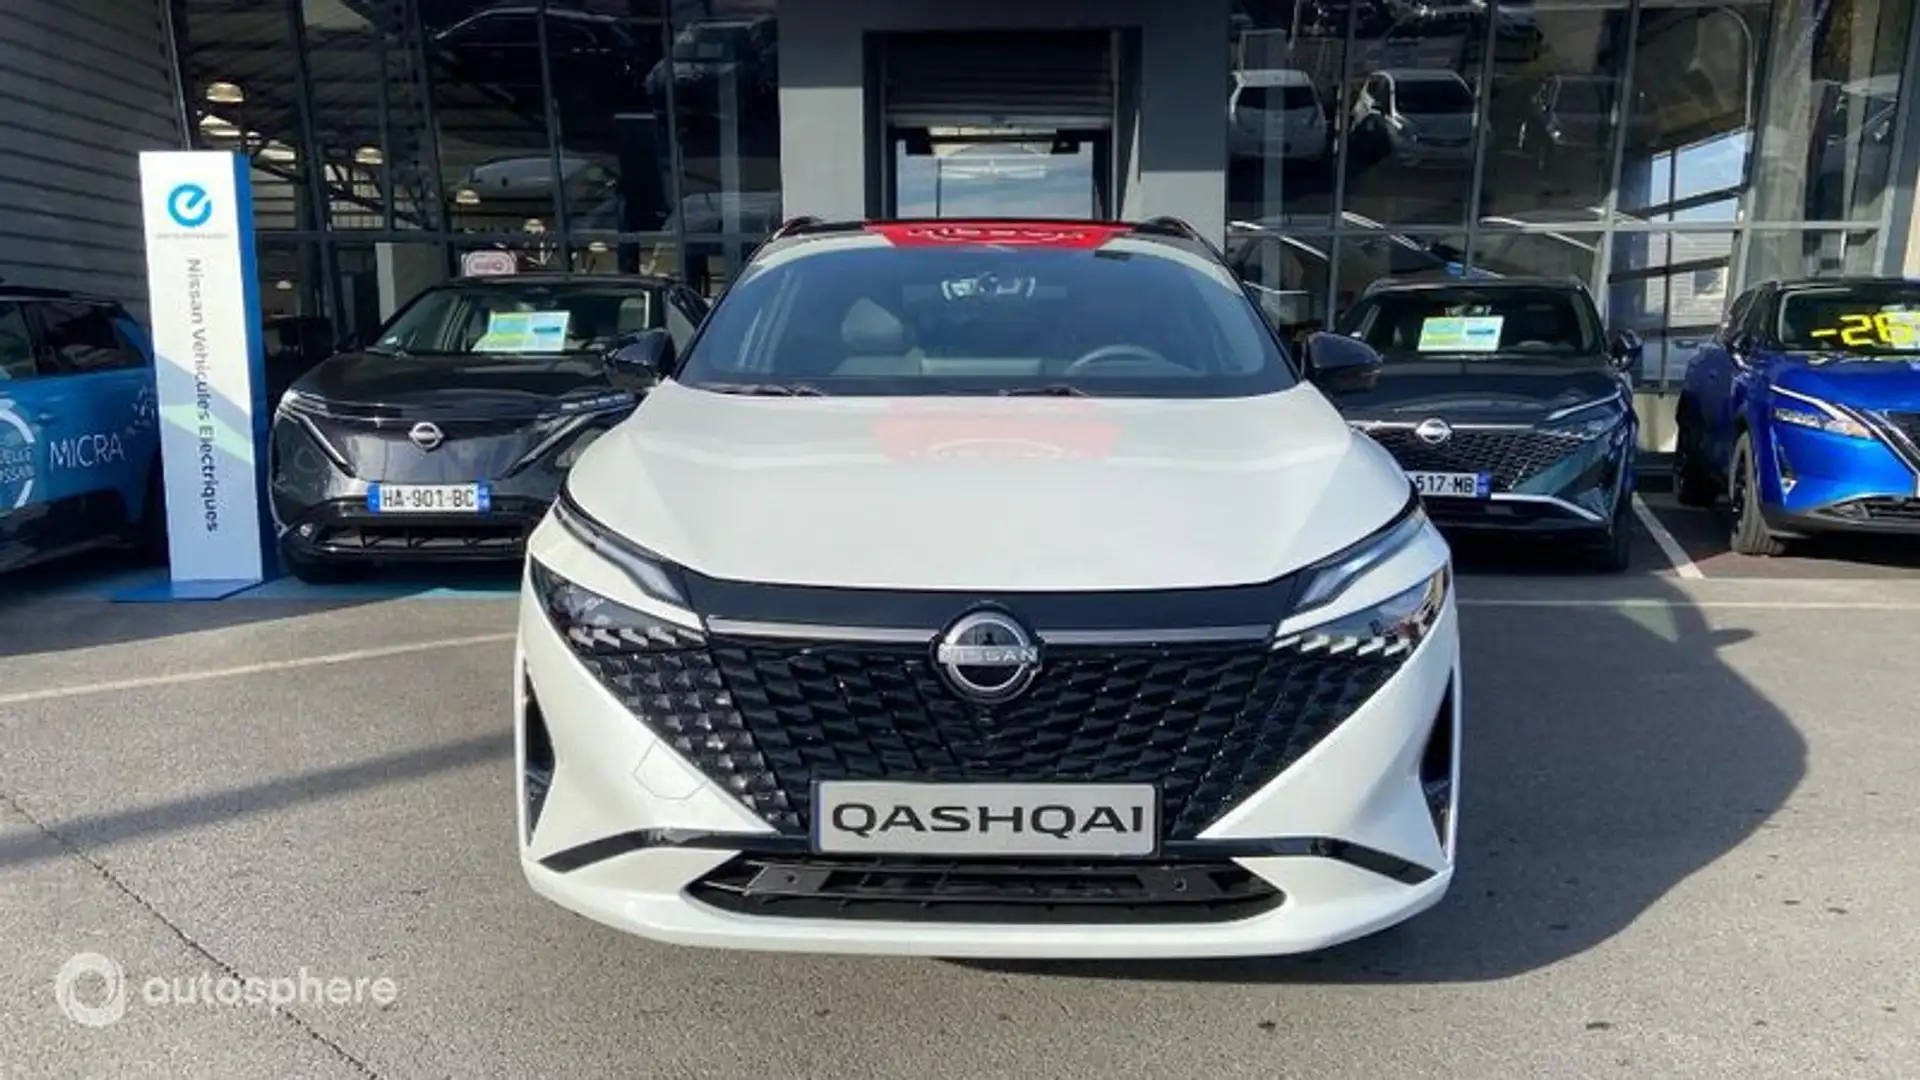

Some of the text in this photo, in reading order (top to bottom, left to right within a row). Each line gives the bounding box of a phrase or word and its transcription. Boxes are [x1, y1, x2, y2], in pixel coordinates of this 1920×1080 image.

[186, 257, 206, 325] Nissan
[50, 432, 125, 470] MICRA
[382, 489, 474, 508] HA-901-BC
[942, 647, 1037, 663] NISSAN
[832, 803, 1144, 839] QASHQAI
